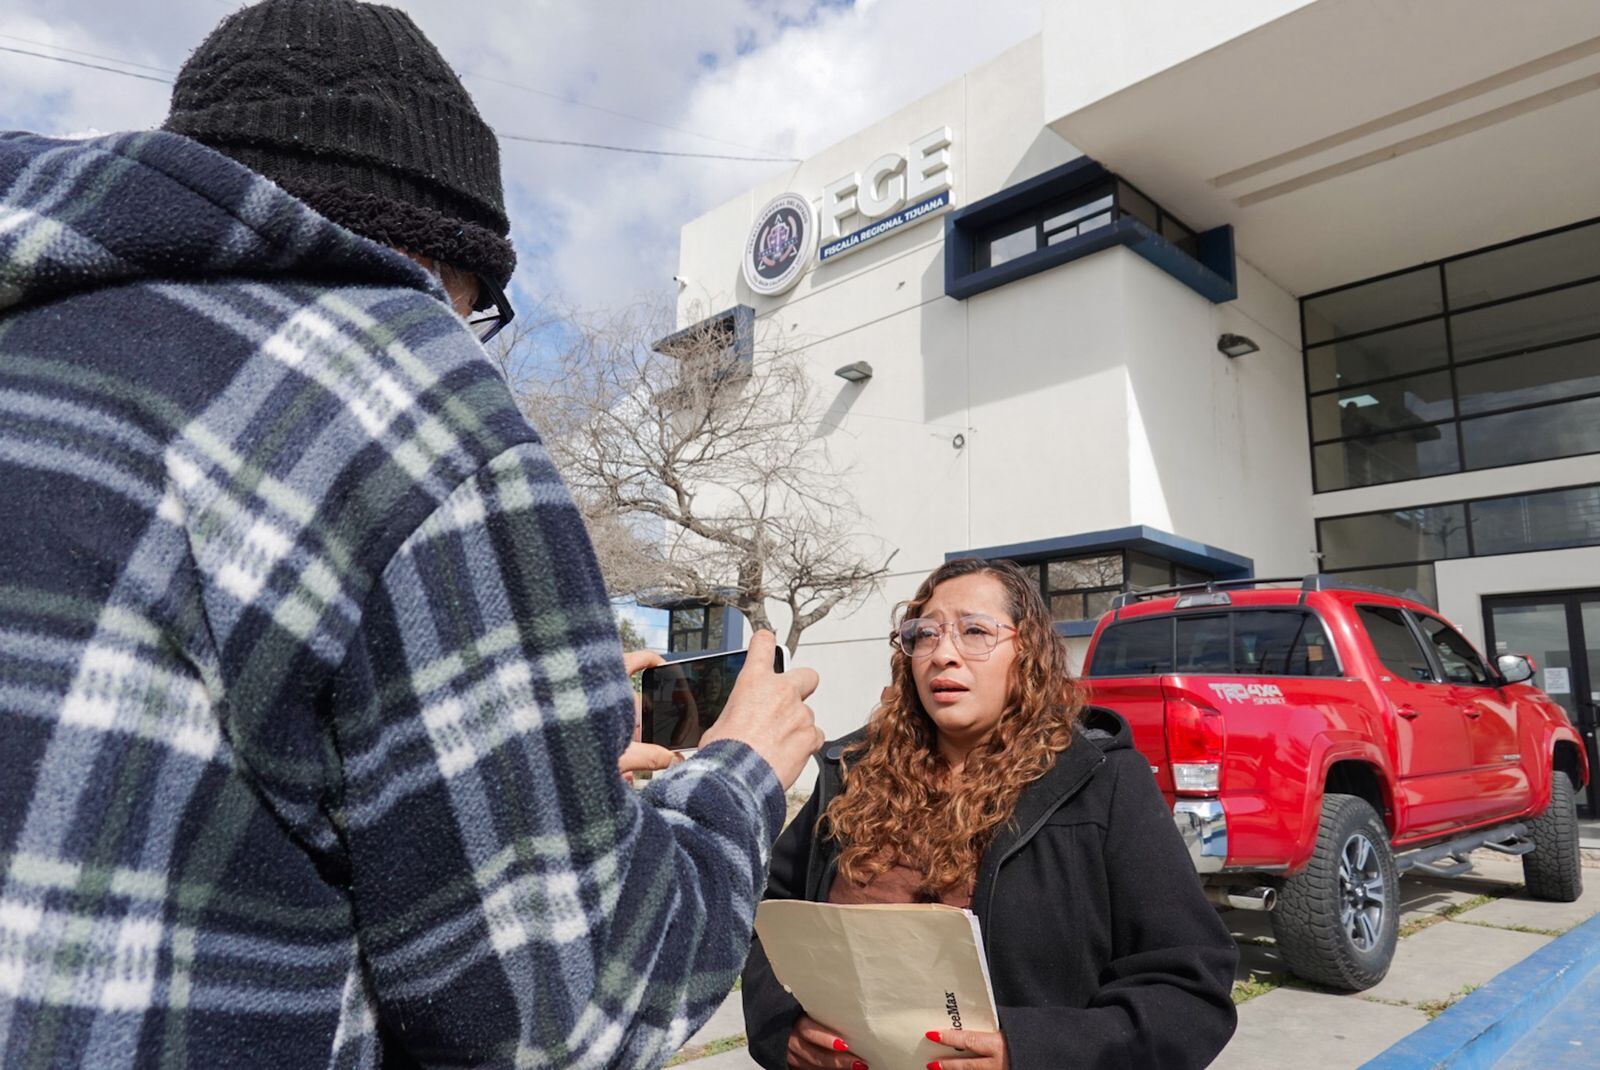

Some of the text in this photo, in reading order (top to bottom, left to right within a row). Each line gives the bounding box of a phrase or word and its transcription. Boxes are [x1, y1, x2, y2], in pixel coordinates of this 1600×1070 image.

[821, 125, 952, 239] FGE
[824, 197, 944, 258] FISCALÍA REGIONAL TIJUANA
[944, 991, 963, 1031] iceMax
